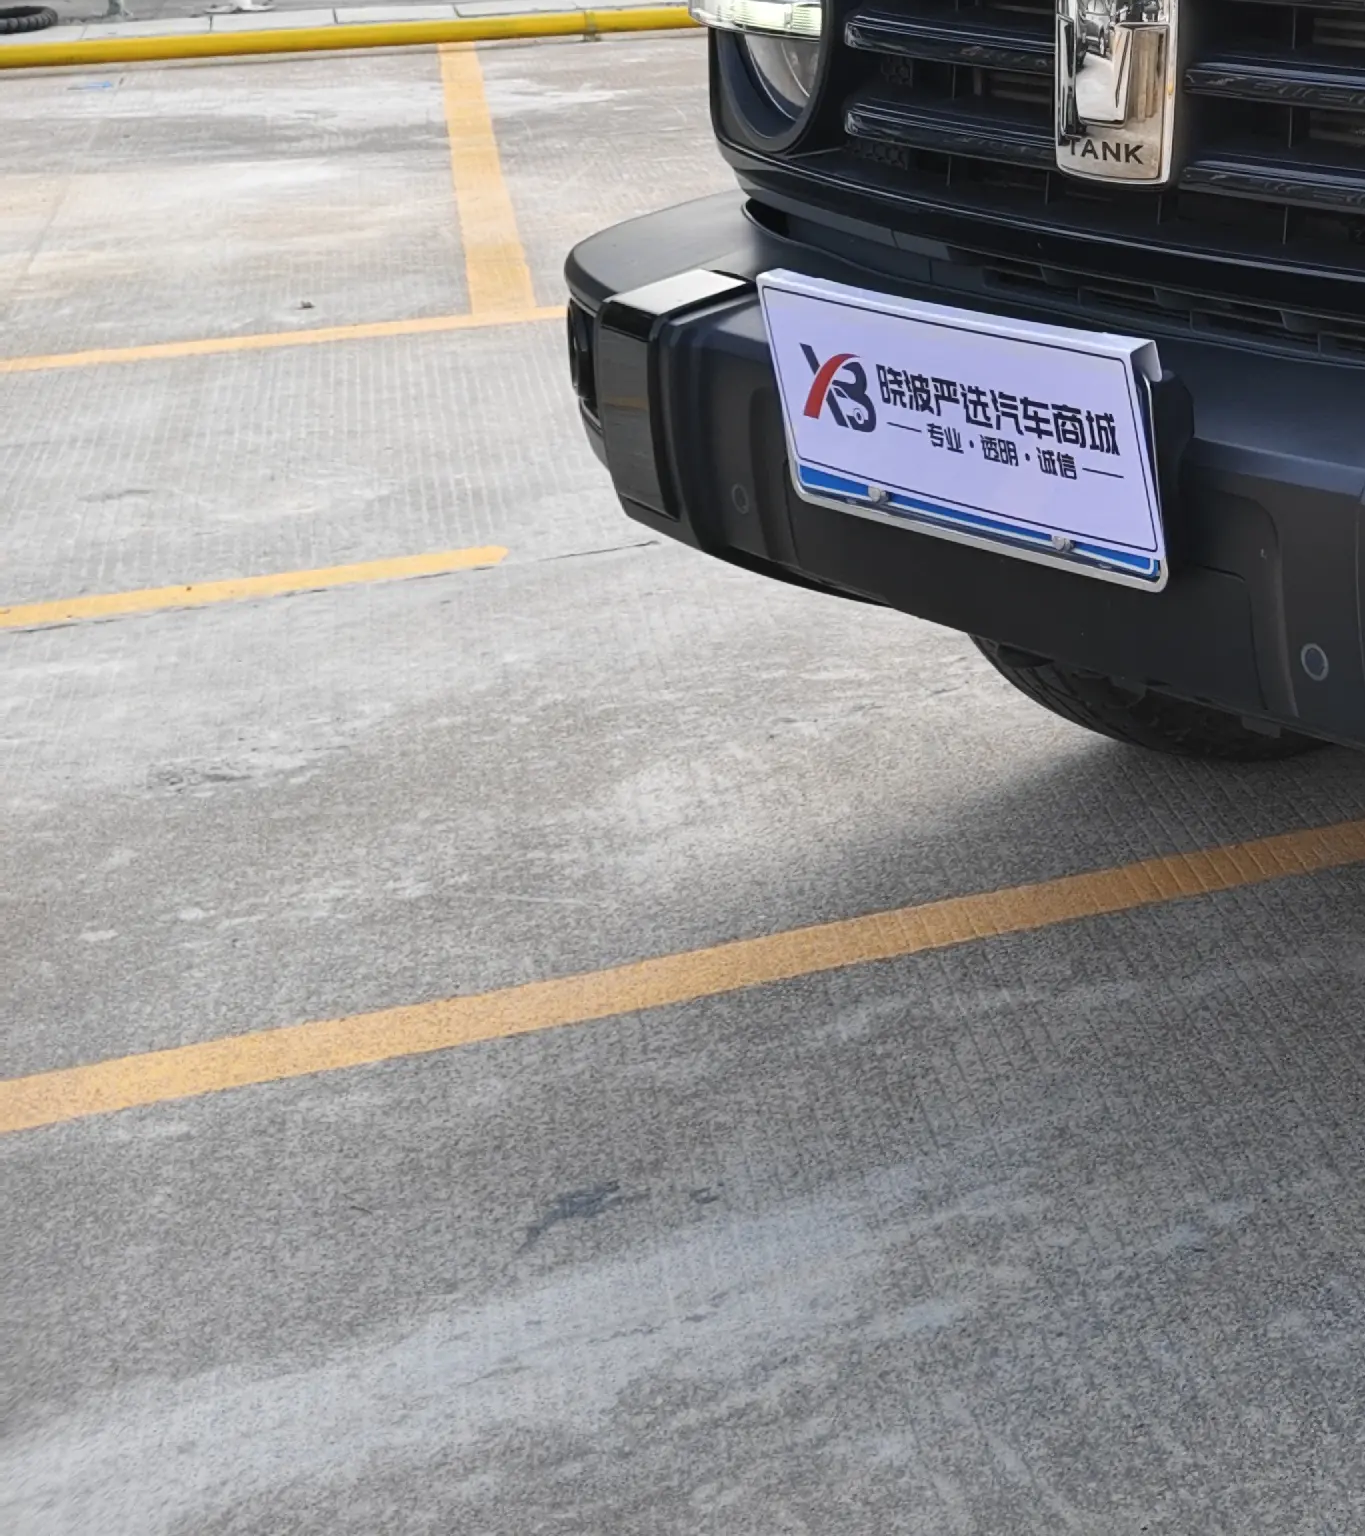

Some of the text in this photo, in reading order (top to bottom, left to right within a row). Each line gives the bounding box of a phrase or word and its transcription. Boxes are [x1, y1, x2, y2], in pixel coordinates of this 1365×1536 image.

[1067, 135, 1145, 165] TANK
[876, 363, 1121, 456] 晓波严选汽车商城
